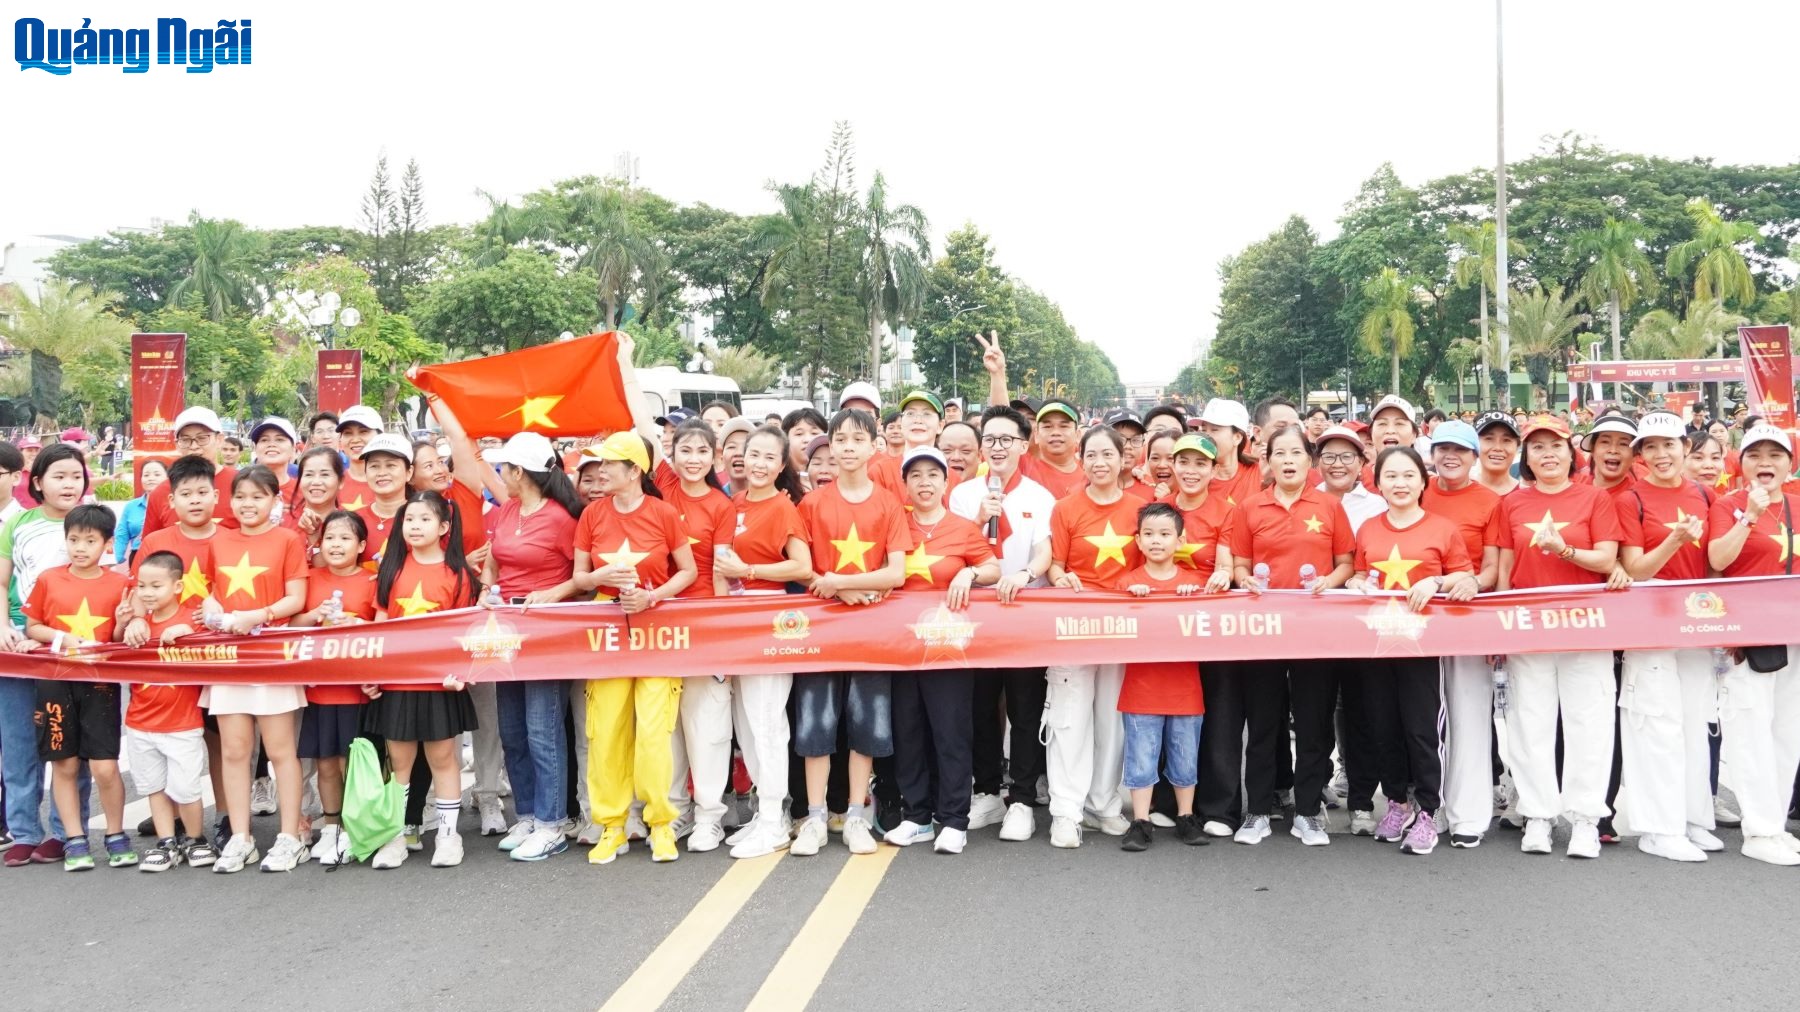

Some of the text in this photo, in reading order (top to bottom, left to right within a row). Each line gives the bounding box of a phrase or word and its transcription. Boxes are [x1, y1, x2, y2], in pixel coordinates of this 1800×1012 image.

[1475, 411, 1518, 429] SPORT
[1055, 615, 1138, 636] Nhân Dân
[1178, 610, 1282, 637] VỀ ĐÍCH
[1497, 604, 1607, 631] VỀ ĐÍCH
[1680, 623, 1741, 634] BỘ CÔNG AN
[284, 634, 384, 661] VỀ ĐÍCH
[587, 622, 690, 651] VỀ ĐÍCH
[763, 645, 821, 657] BỘ CÔNG AN
[46, 702, 64, 751] STARS
